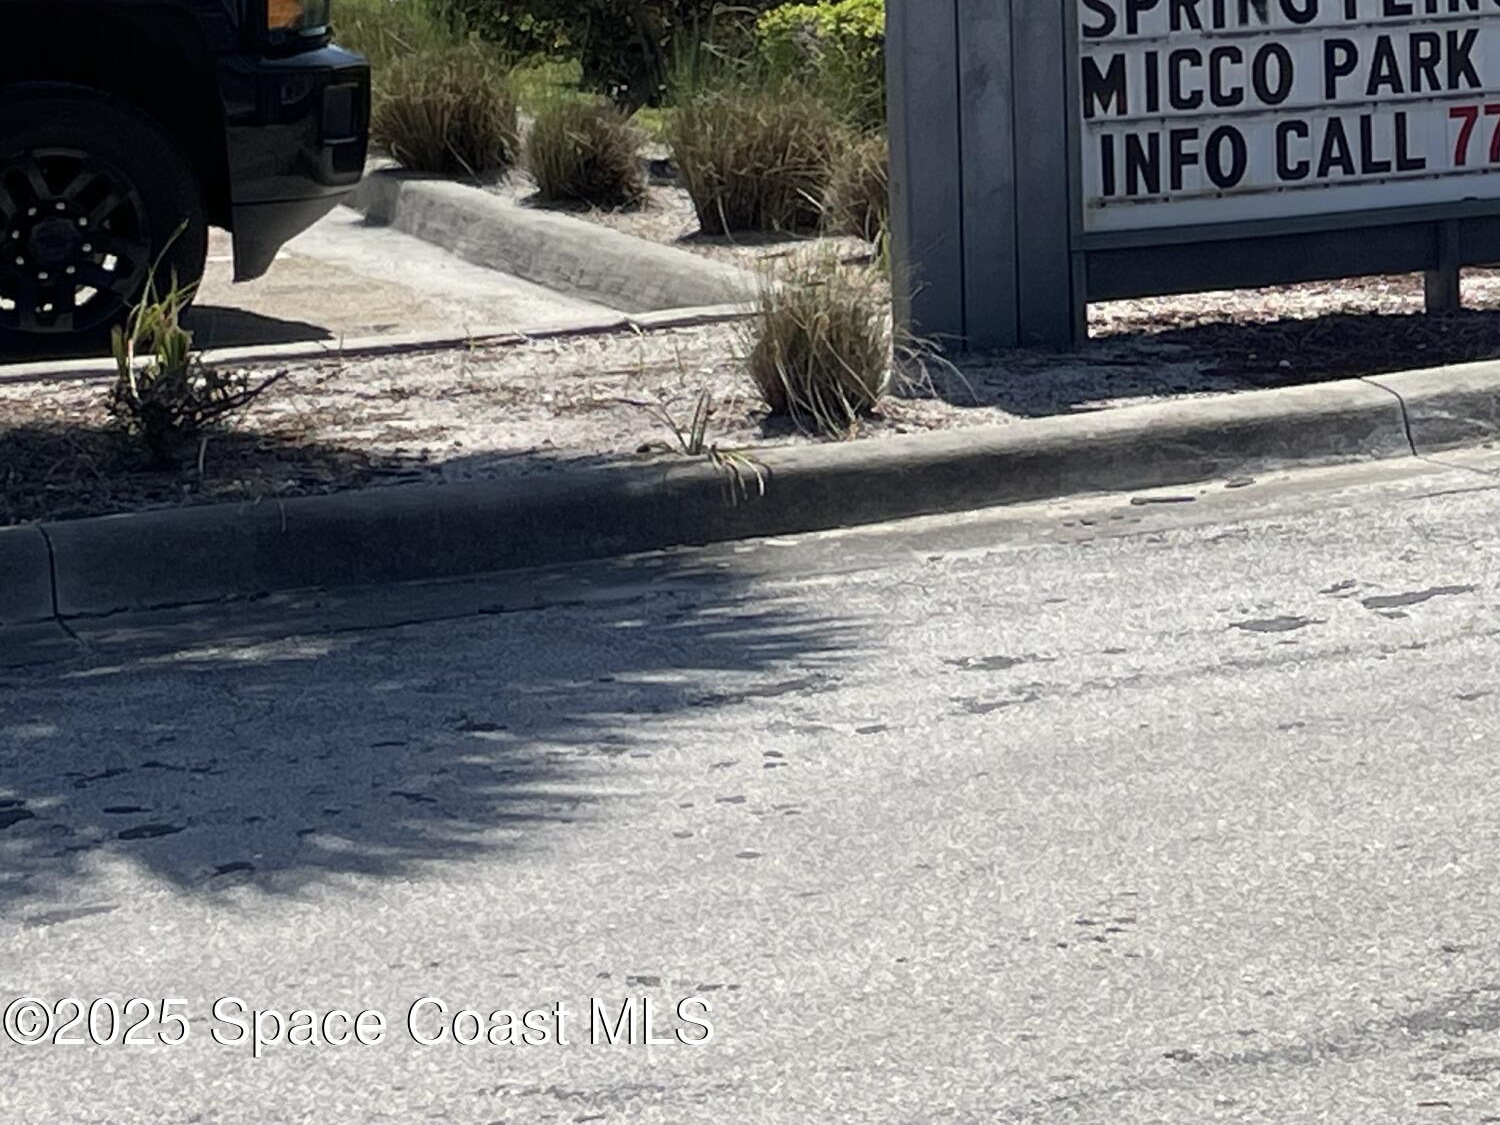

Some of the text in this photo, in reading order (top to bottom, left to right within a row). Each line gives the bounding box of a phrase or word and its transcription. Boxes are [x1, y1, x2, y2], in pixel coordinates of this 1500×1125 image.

[1083, 42, 1294, 119] MICCO
[1323, 29, 1482, 97] PARK
[1101, 124, 1247, 196] INFO
[1276, 112, 1426, 181] CALL
